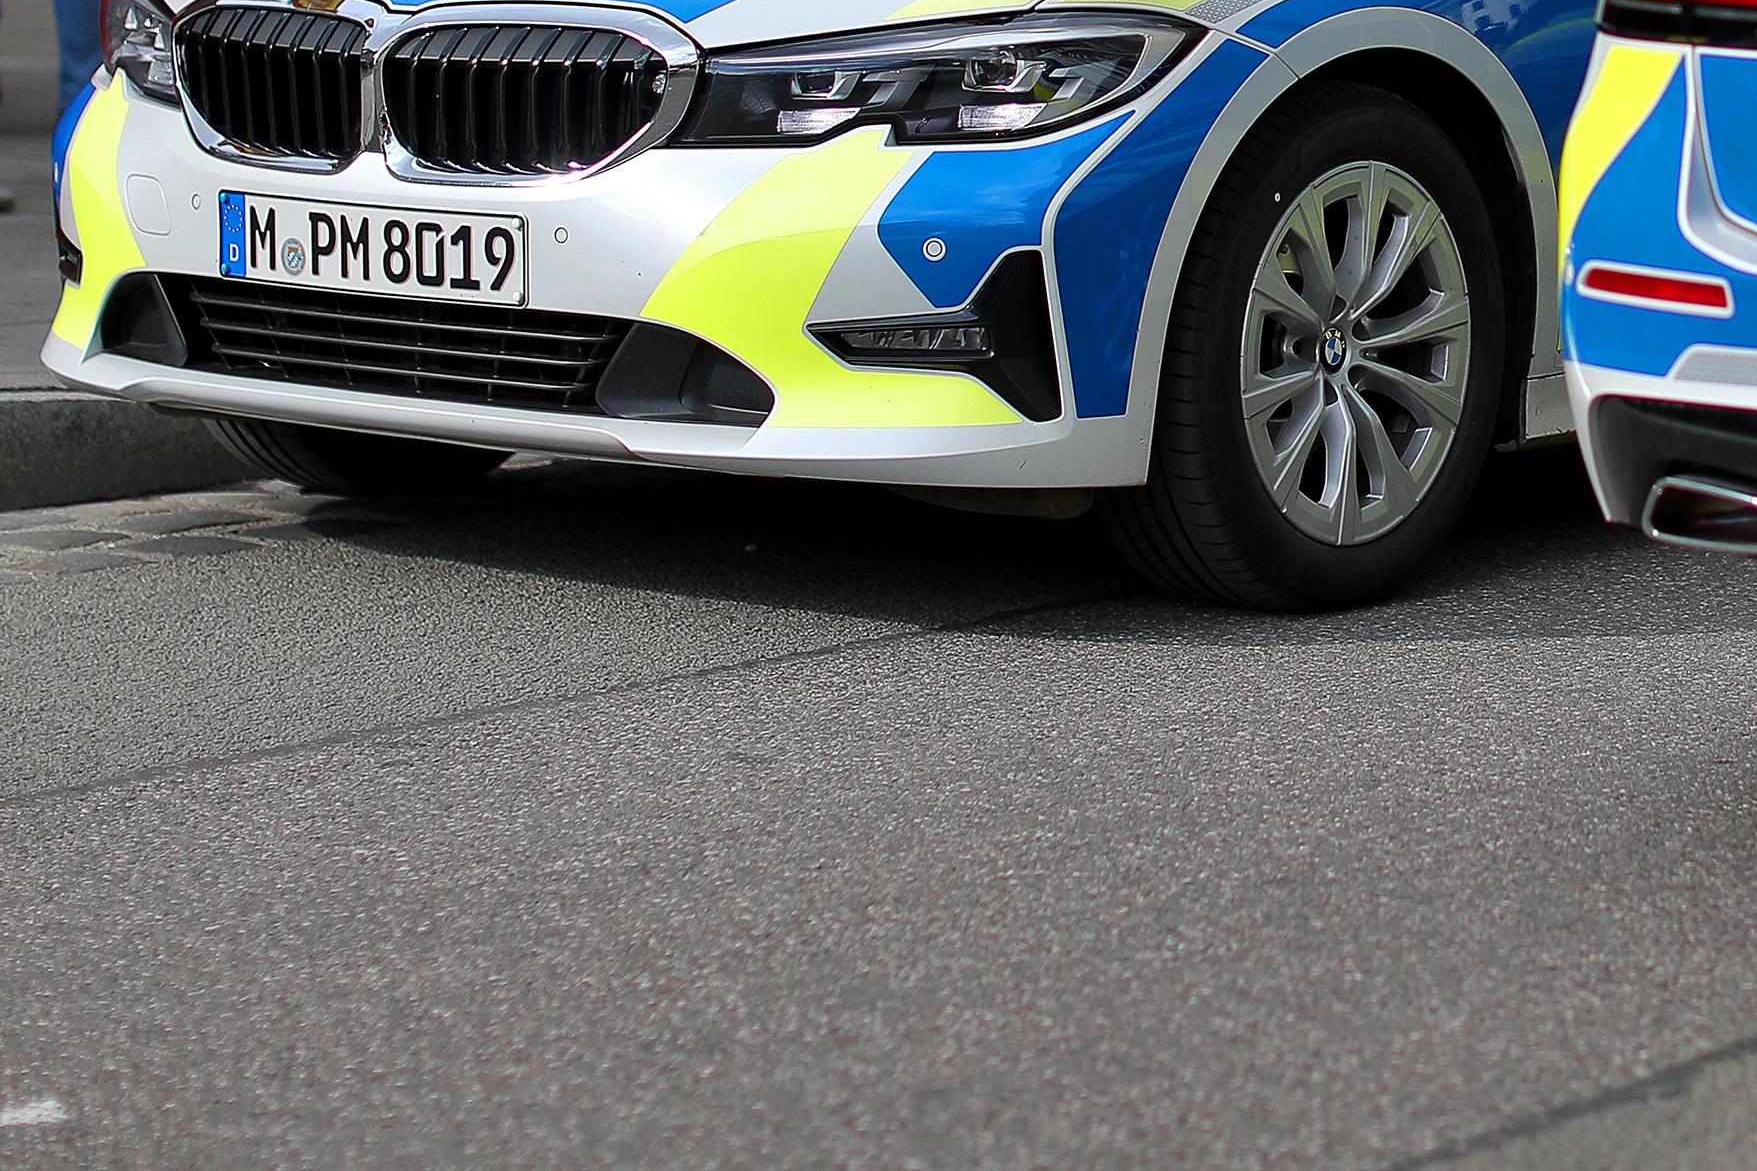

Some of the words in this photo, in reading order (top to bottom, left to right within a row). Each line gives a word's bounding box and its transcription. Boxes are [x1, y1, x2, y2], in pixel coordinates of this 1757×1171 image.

[229, 243, 240, 261] D
[250, 205, 276, 271] M
[308, 211, 370, 281] PM
[383, 219, 515, 291] 8019
